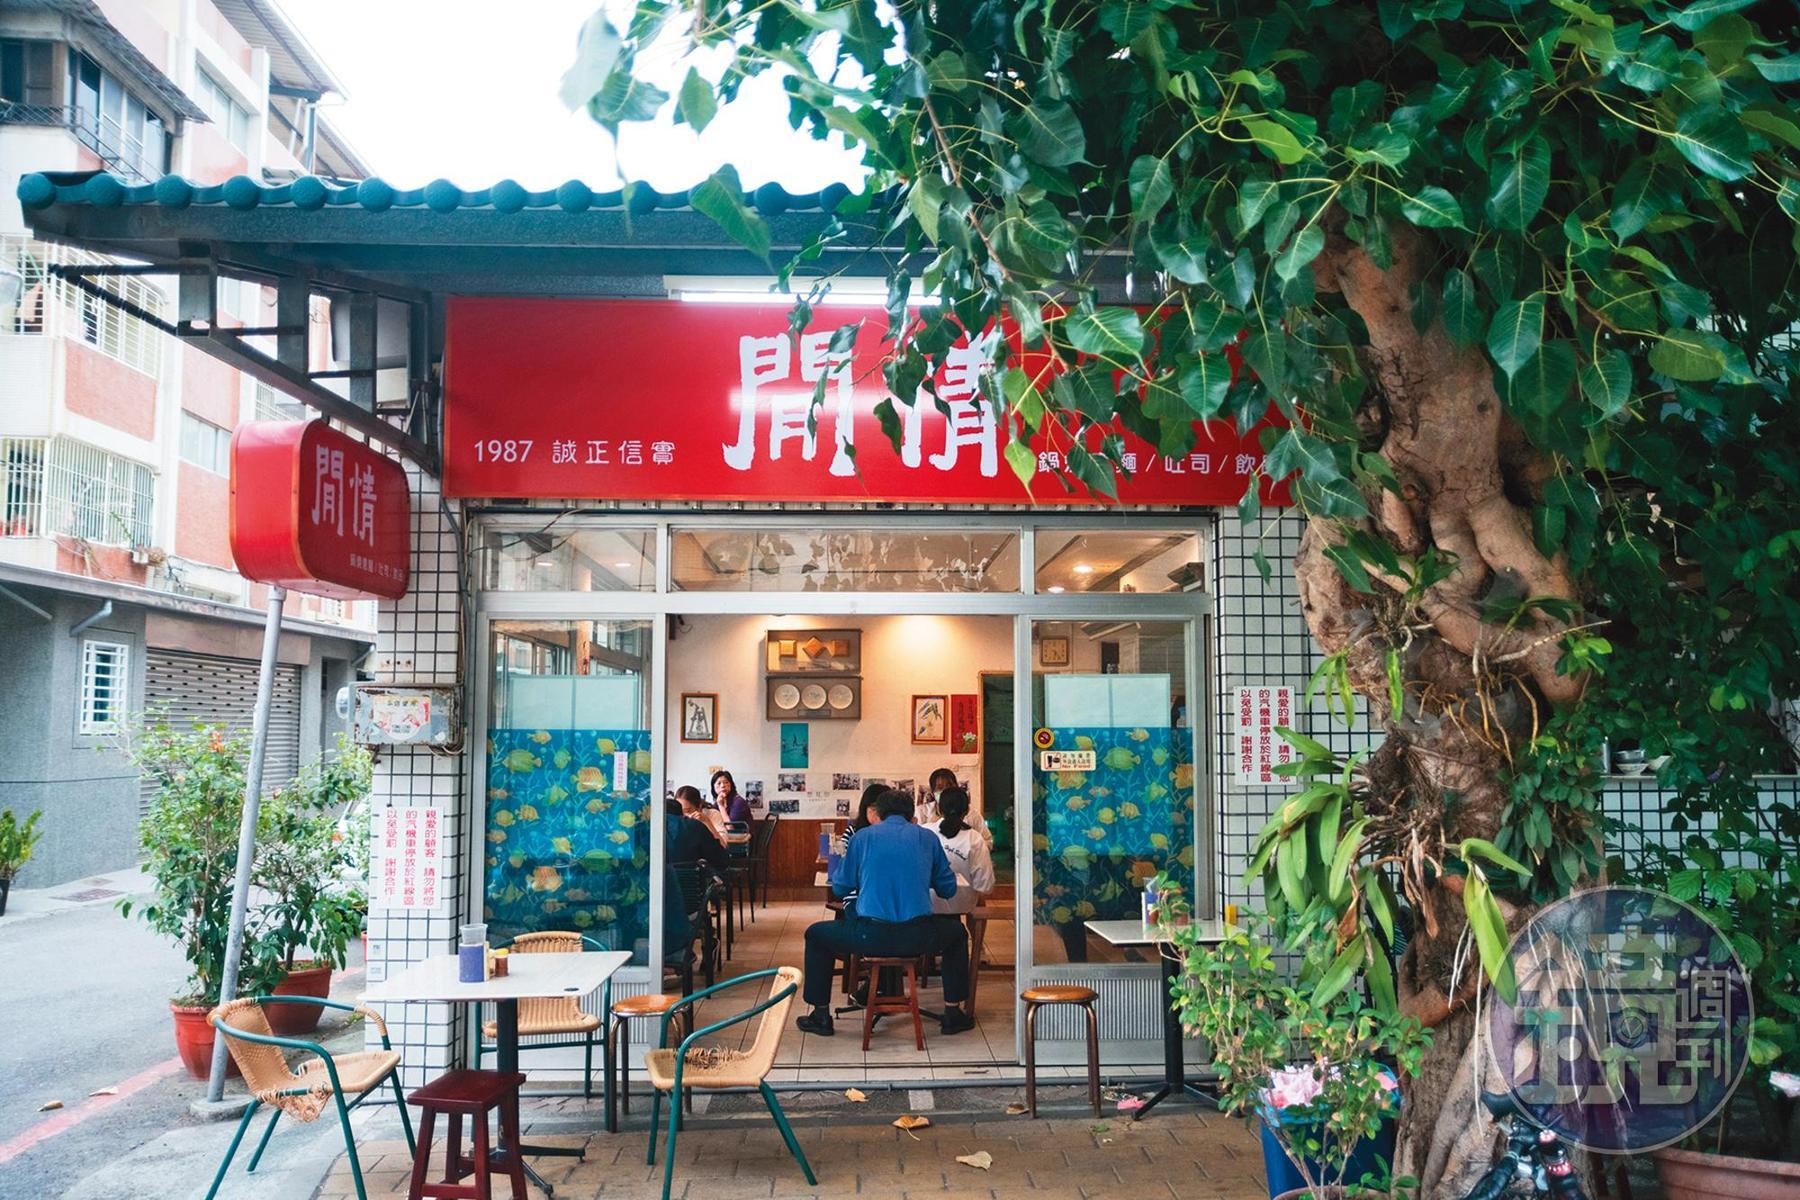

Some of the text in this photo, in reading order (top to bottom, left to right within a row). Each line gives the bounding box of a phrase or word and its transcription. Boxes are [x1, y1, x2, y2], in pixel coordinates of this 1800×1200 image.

[473, 439, 676, 465] 1987 誠正信實
